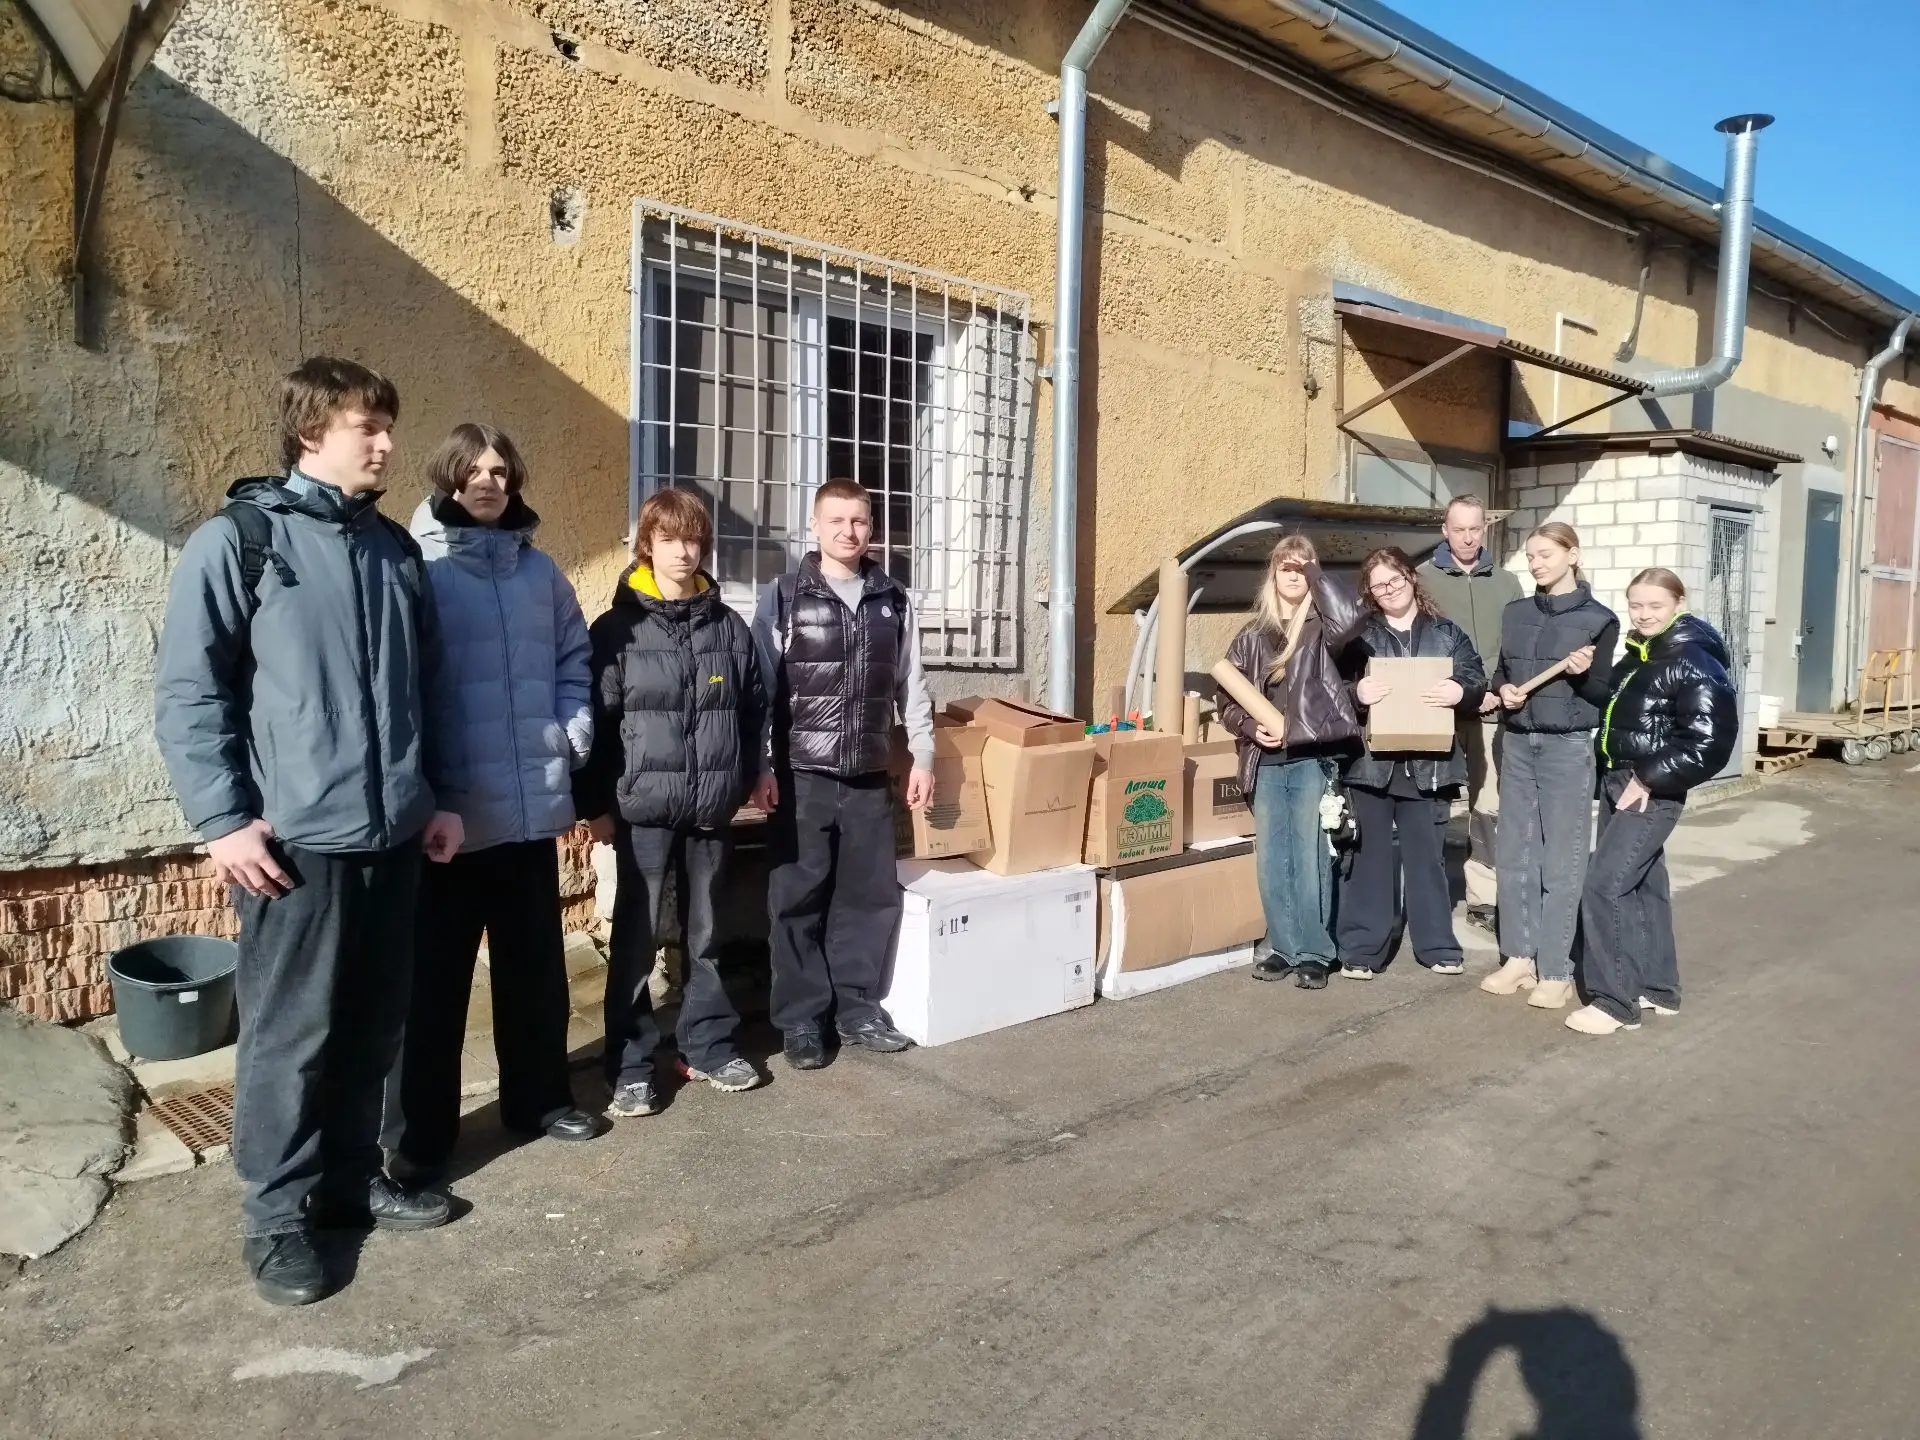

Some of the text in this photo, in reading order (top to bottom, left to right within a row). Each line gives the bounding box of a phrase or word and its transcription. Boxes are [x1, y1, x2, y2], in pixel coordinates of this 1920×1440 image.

[1124, 779, 1166, 795] Лапша
[1219, 783, 1242, 798] TESS
[1118, 821, 1171, 847] КЭММИ
